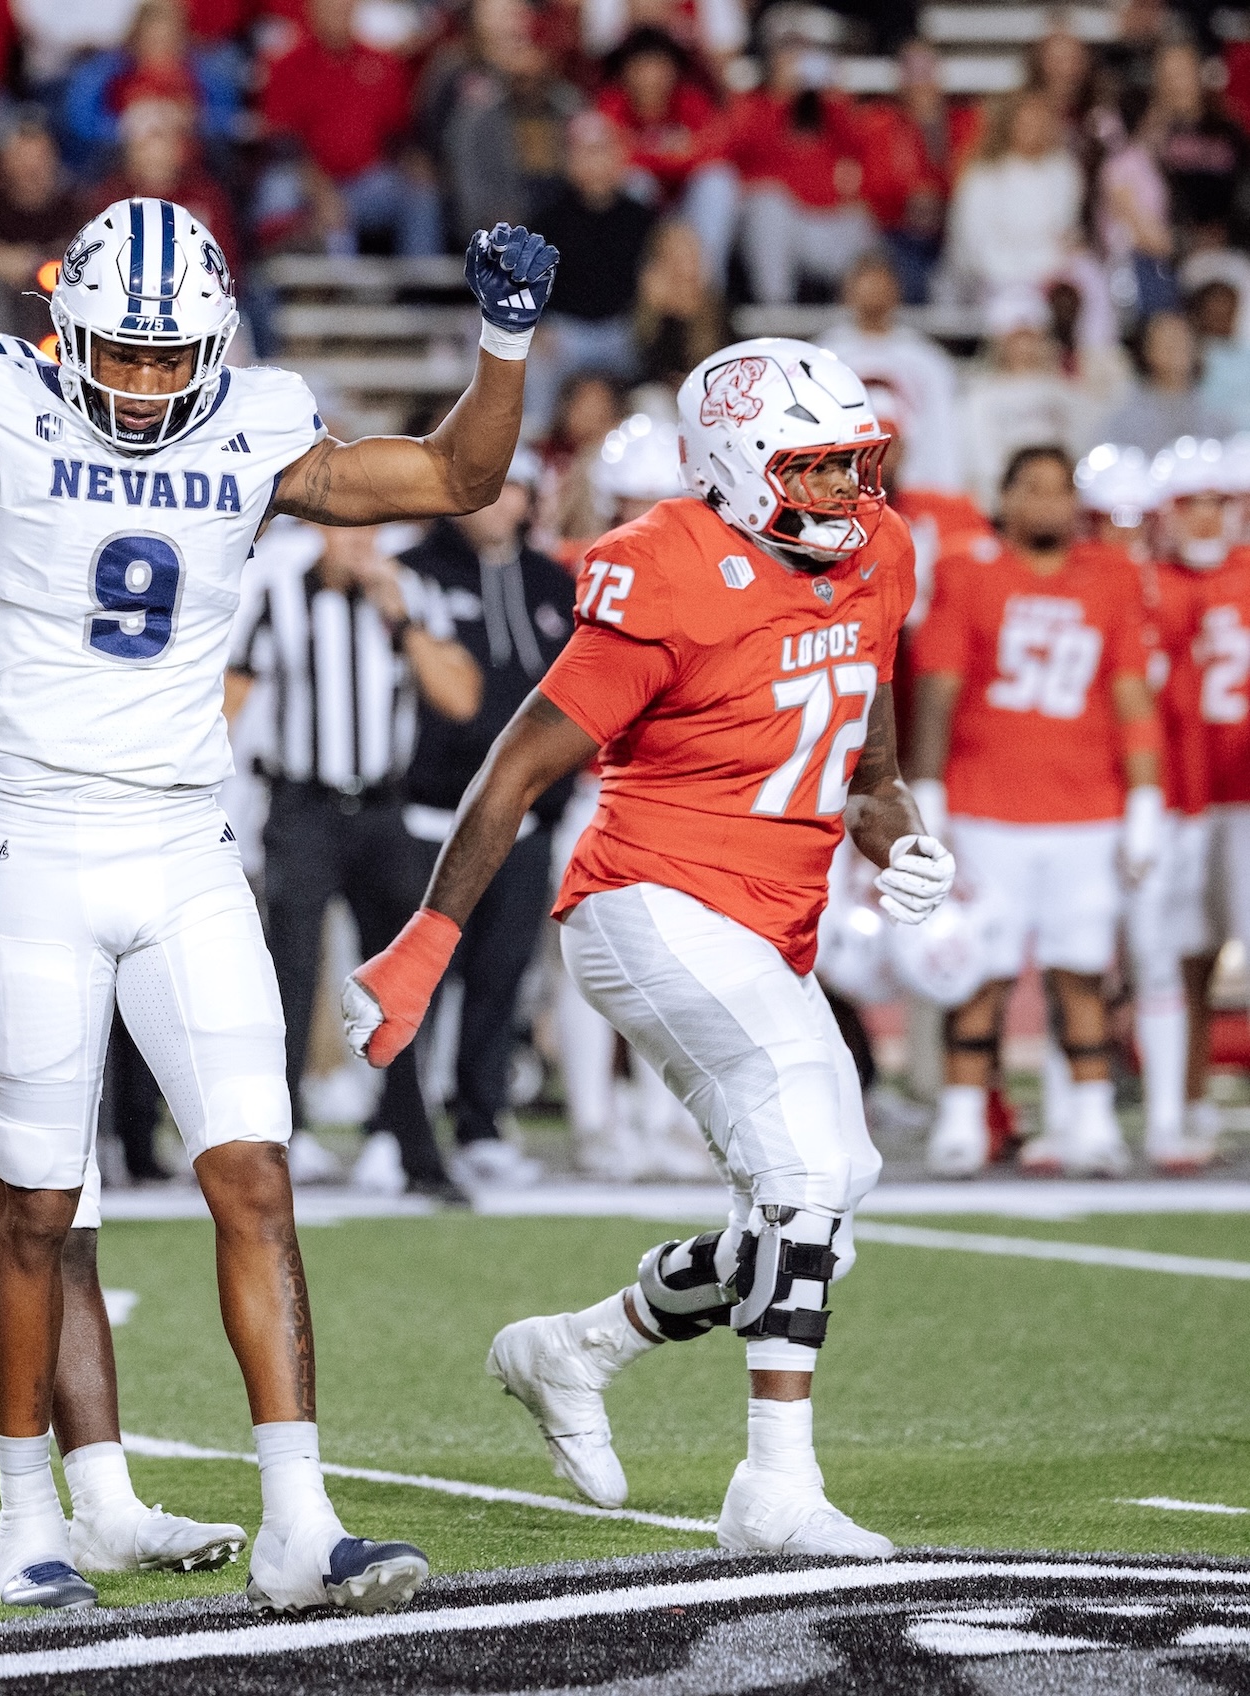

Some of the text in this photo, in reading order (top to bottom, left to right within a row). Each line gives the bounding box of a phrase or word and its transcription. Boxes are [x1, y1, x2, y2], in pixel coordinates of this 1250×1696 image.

[135, 317, 165, 332] 775
[49, 456, 242, 513] NEVADA
[82, 528, 187, 666] 9
[579, 559, 635, 624] 72
[780, 621, 861, 672] LOBOS
[749, 661, 879, 817] 72
